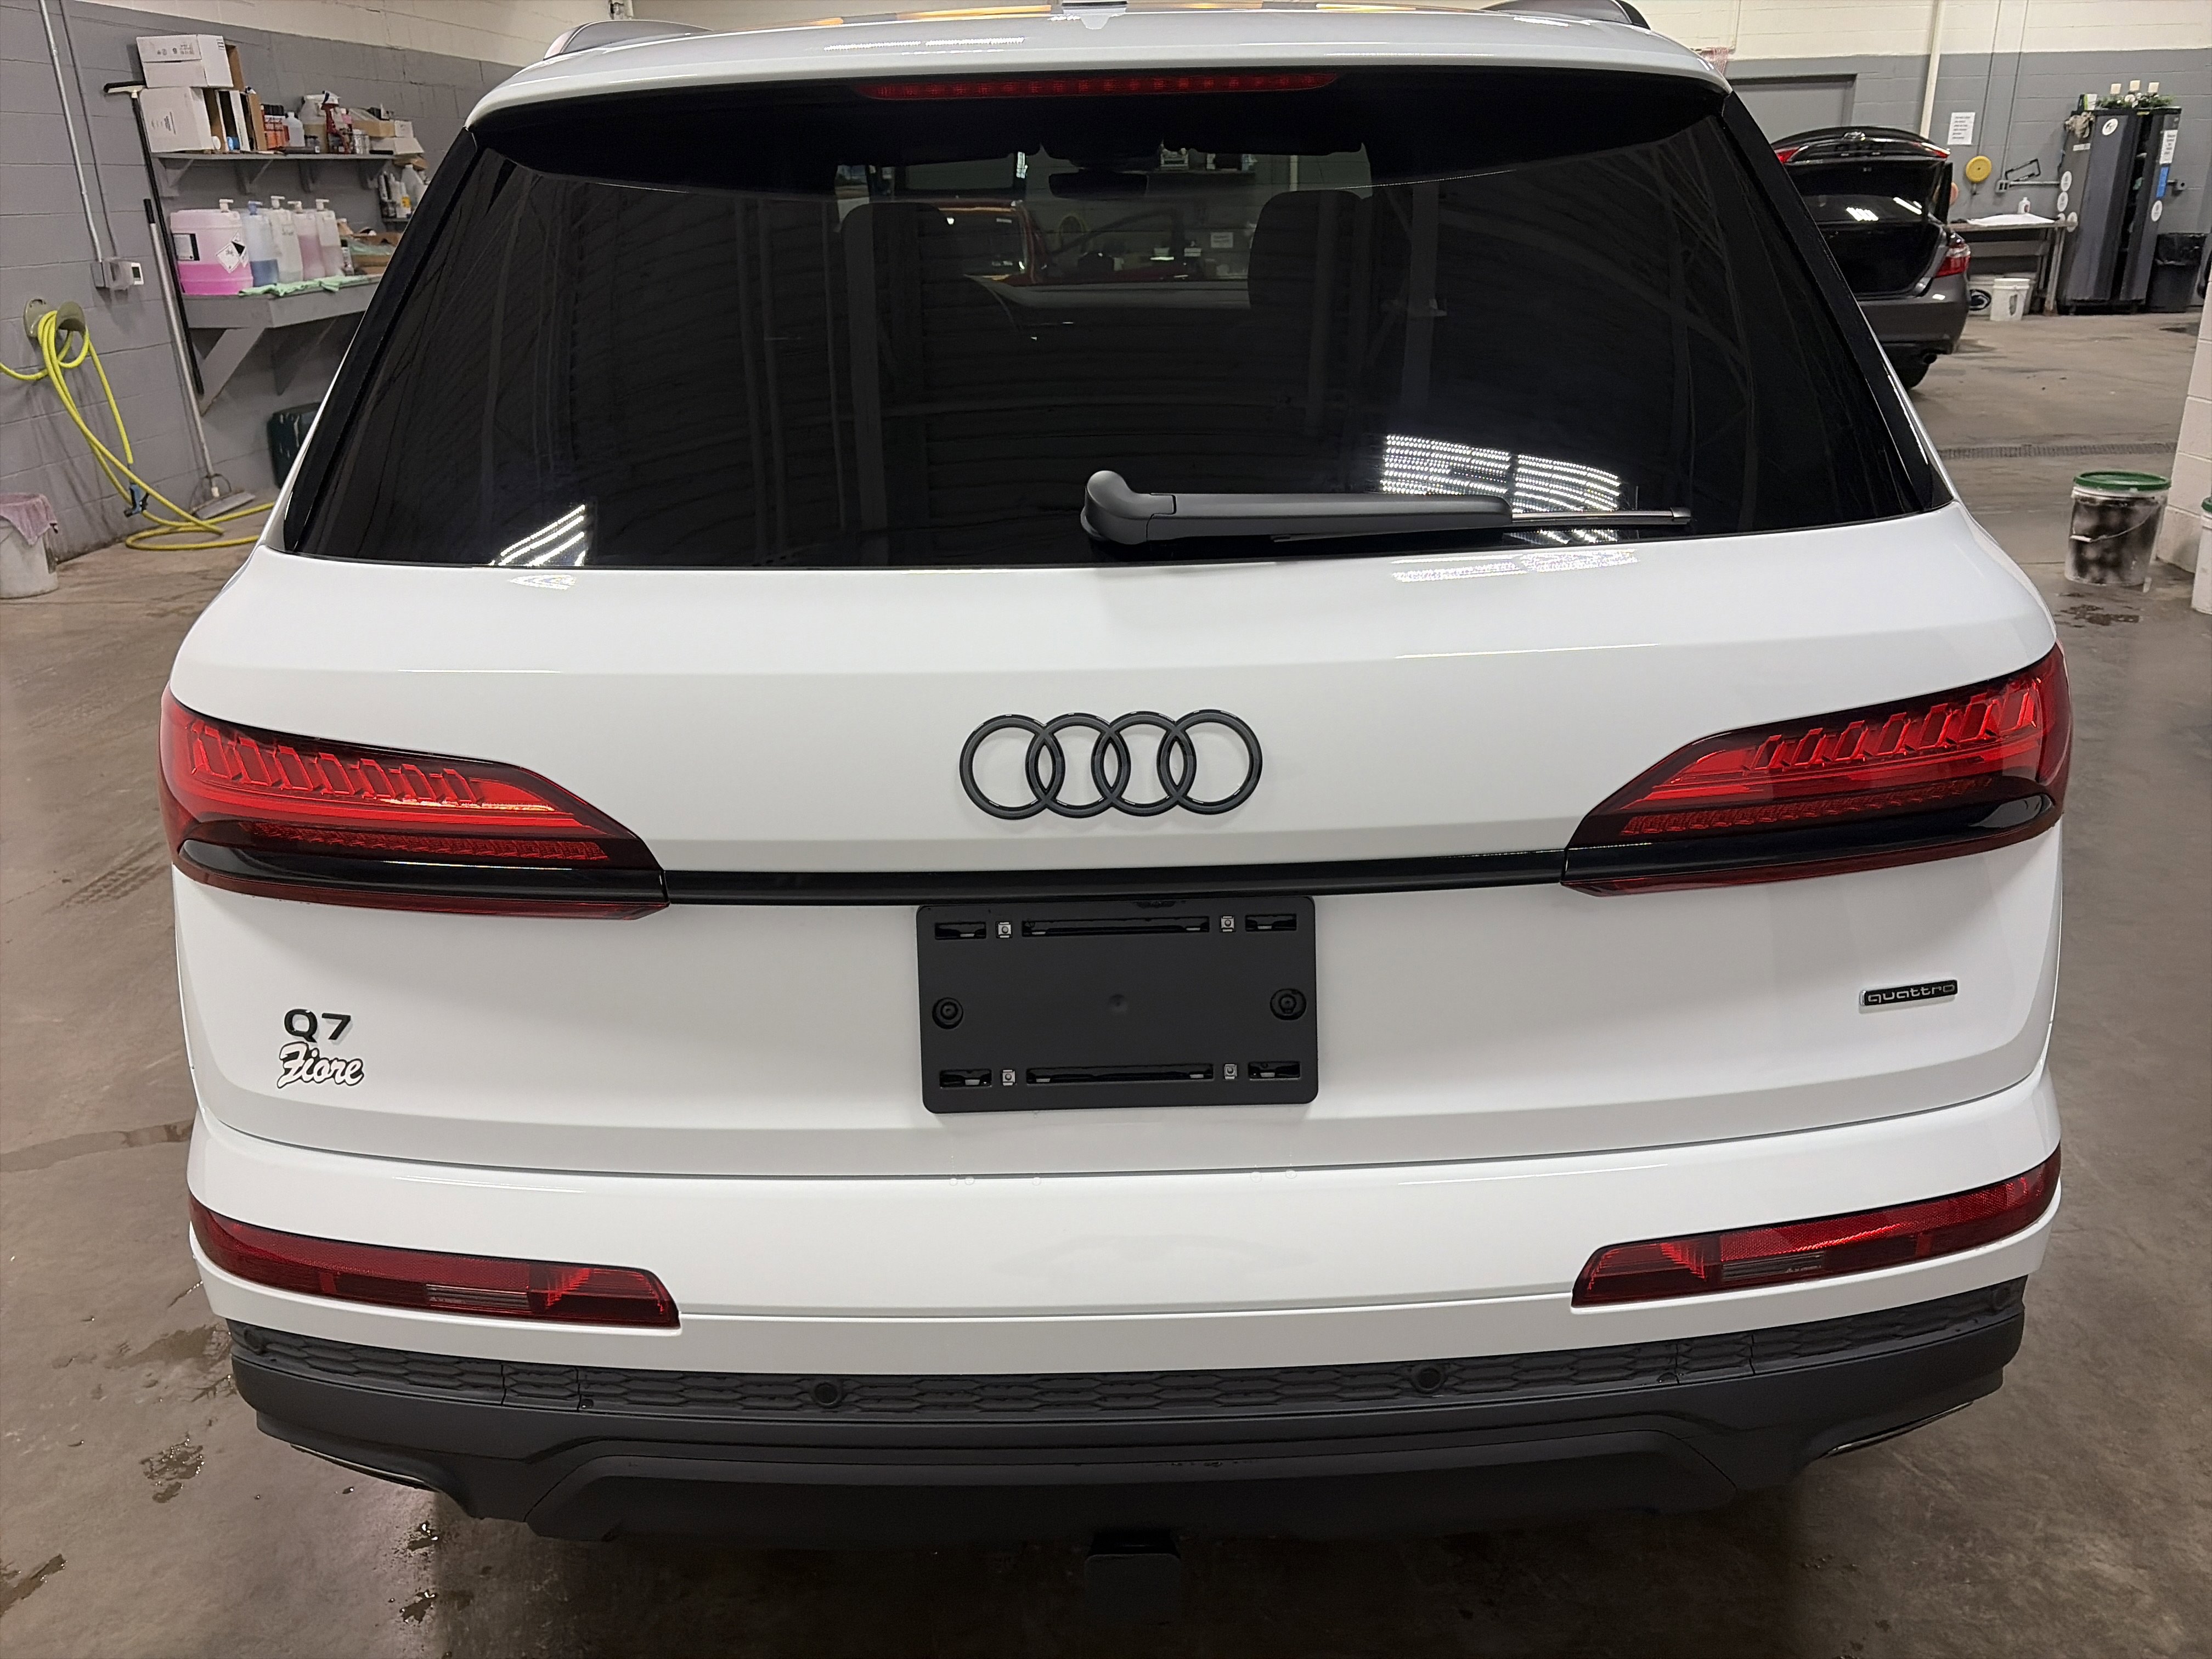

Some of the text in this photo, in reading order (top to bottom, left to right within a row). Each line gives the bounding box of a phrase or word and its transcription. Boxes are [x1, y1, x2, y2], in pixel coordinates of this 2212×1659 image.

[1868, 984, 1955, 1003] quattro
[284, 1008, 351, 1043] Q7
[277, 1041, 364, 1089] Fiore
